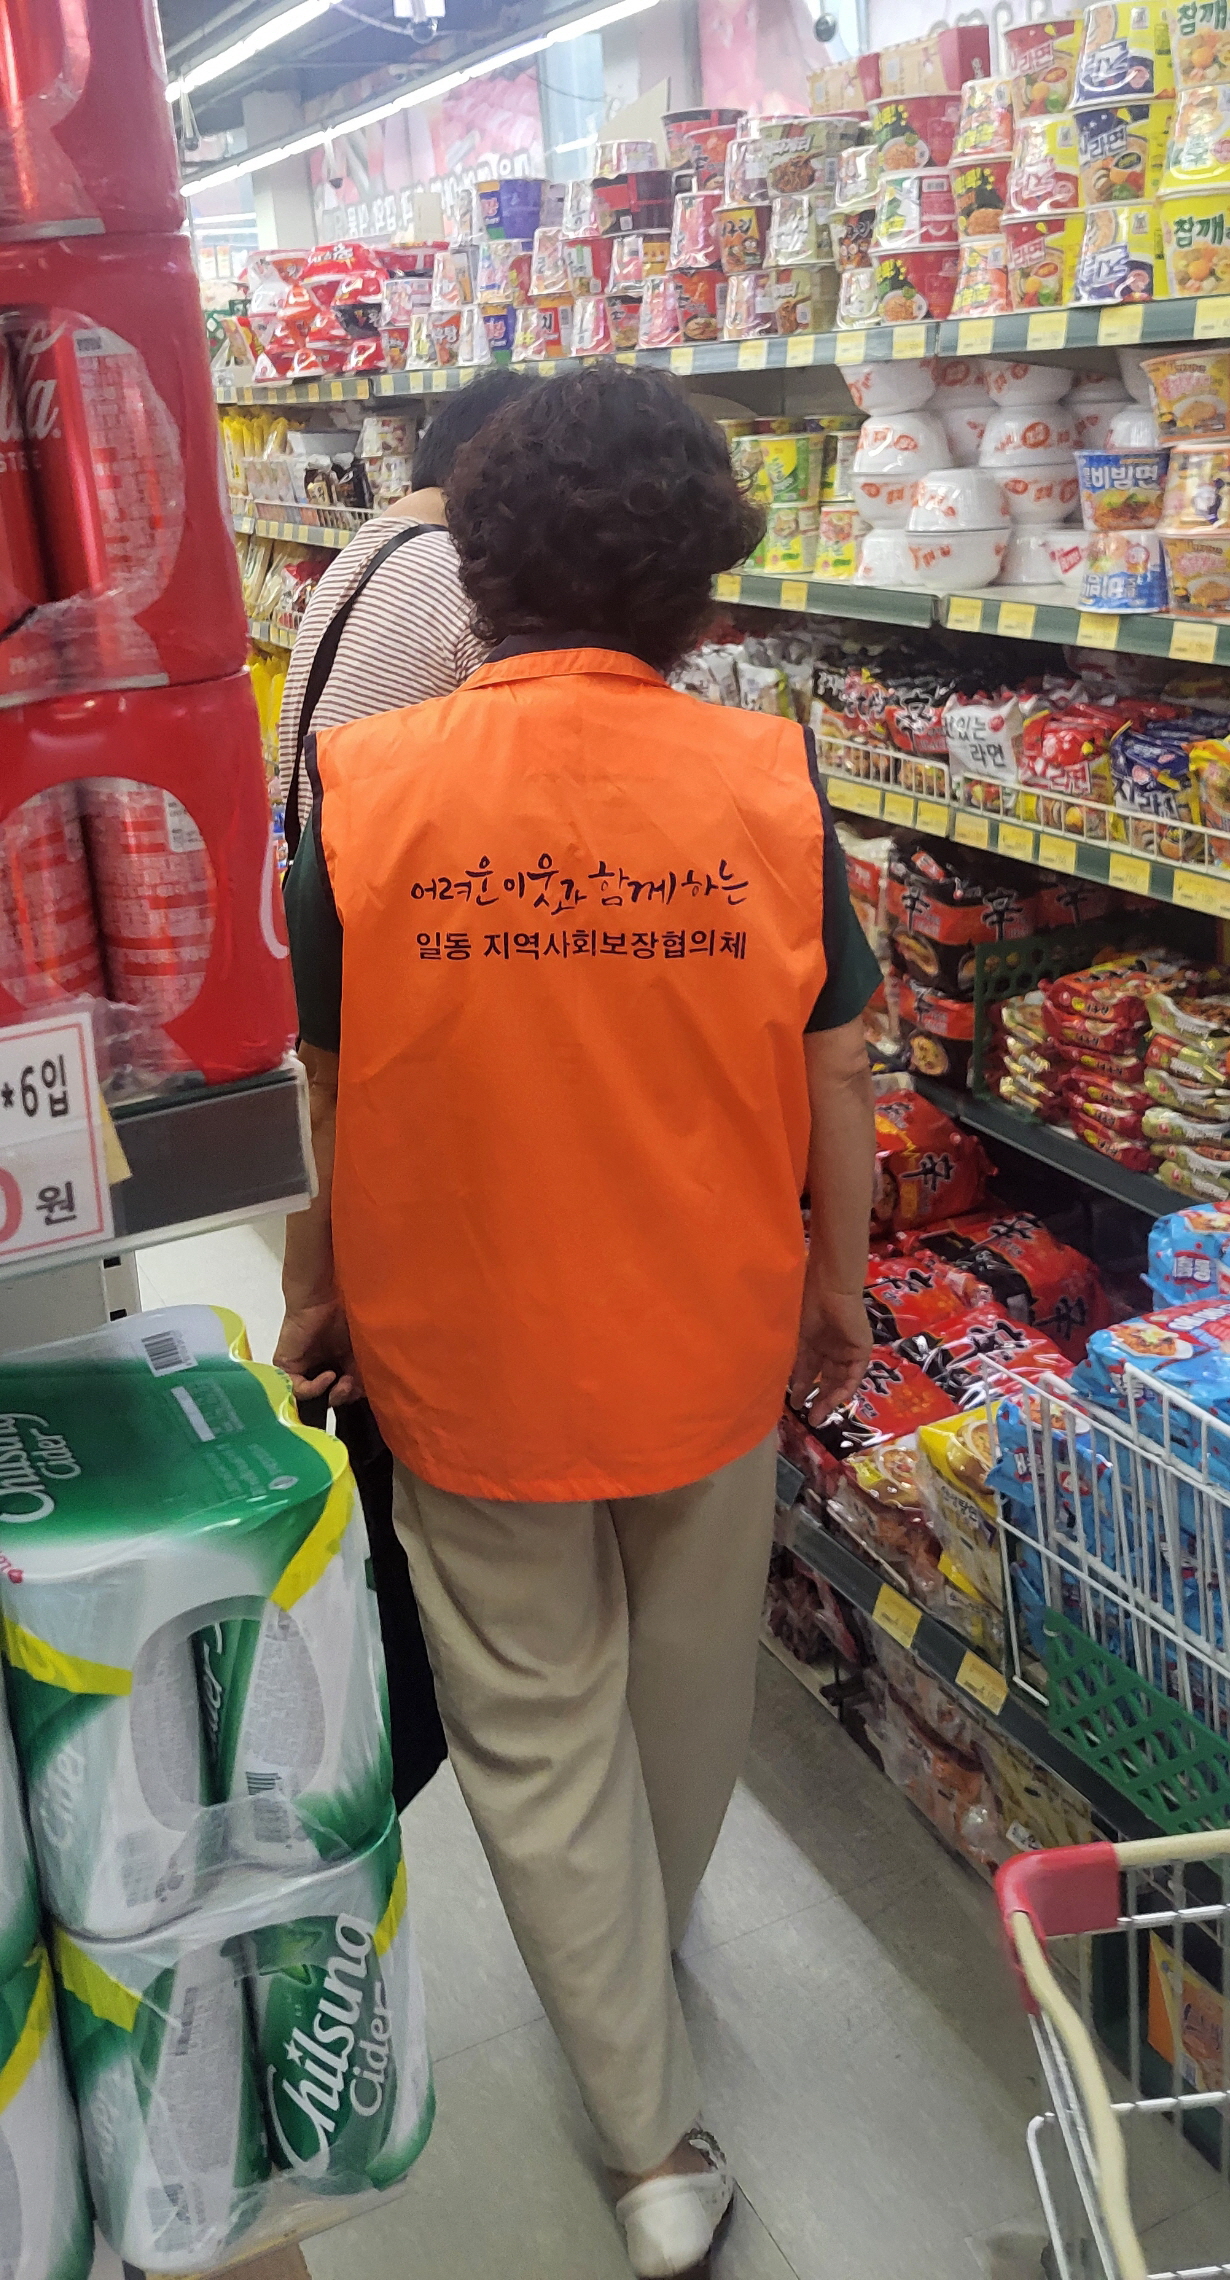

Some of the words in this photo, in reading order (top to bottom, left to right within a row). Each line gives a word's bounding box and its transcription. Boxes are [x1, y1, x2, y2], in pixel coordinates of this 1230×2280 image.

[1177, 1, 1230, 36] 참깨
[1173, 216, 1230, 248] 참깨
[1090, 464, 1159, 491] 비빔면
[971, 744, 1006, 768] 라면
[410, 855, 500, 908] 어려운
[502, 853, 588, 916] 이웃과
[588, 859, 677, 908] 함께
[681, 858, 750, 906] 하는
[416, 931, 472, 961] 일동
[483, 928, 748, 961] 지역사회보장협의체
[36, 1180, 77, 1226] 원
[30, 1428, 82, 1480] Cider
[266, 1912, 374, 2178] Chilsung
[350, 1980, 394, 2118] Cider
